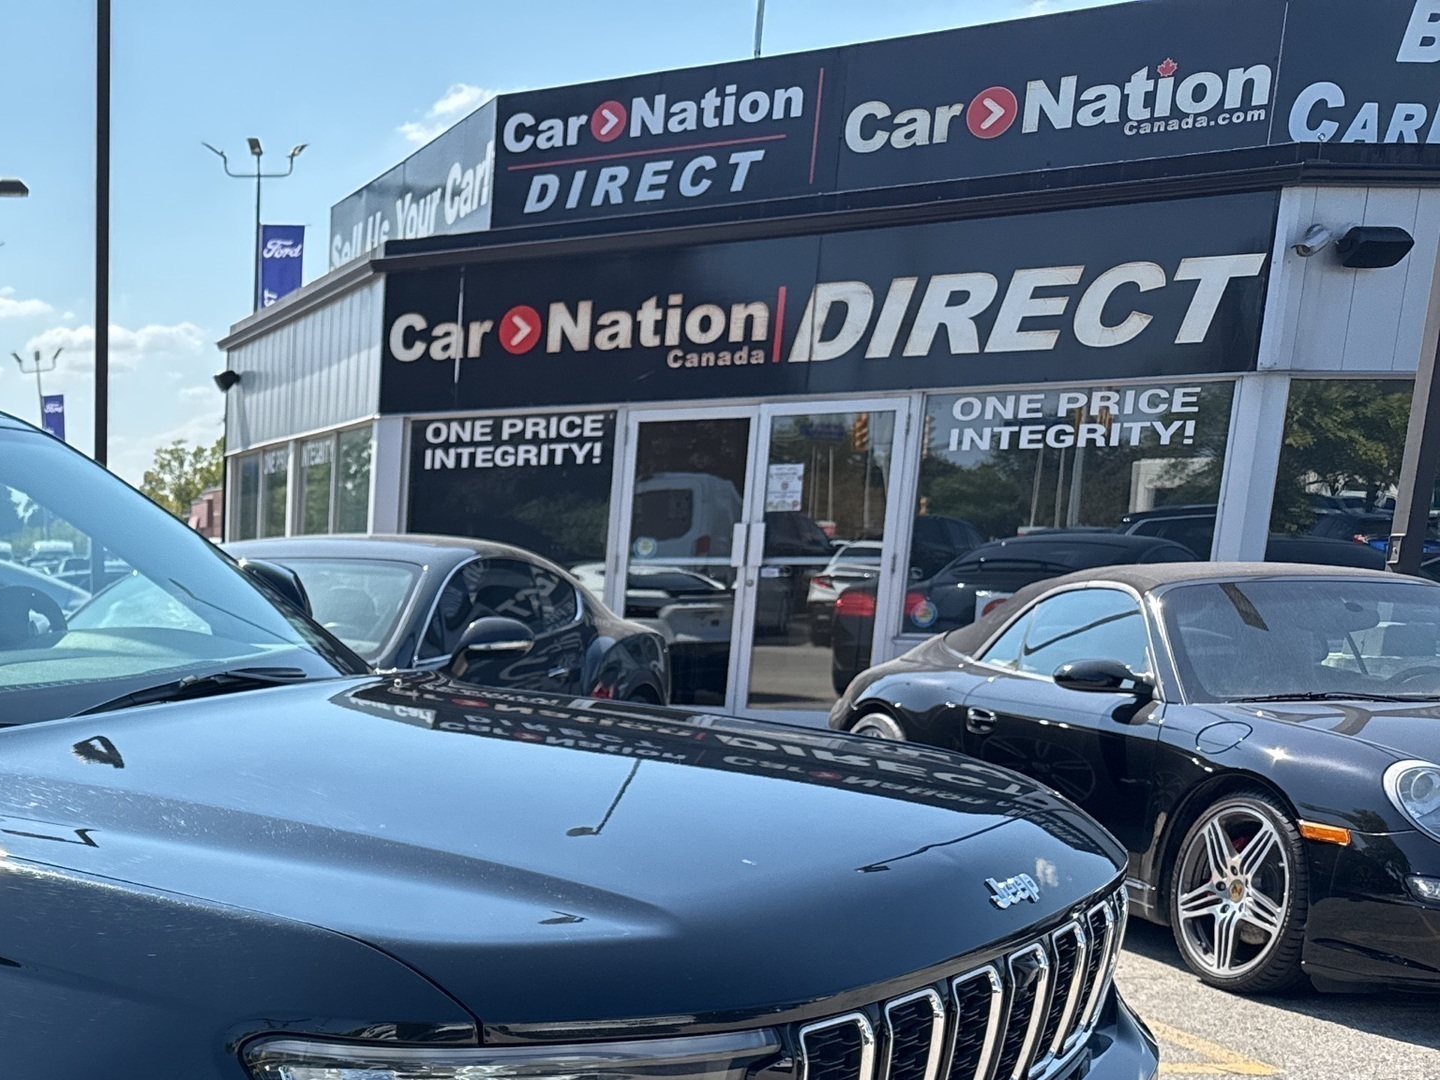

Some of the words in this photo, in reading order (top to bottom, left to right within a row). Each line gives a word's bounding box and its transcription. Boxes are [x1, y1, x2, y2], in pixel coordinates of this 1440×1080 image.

[503, 112, 587, 153] Car
[629, 85, 804, 137] Nation
[845, 100, 964, 154] Car
[1022, 64, 1272, 134] Nation
[1123, 108, 1266, 136] Canada.com
[1288, 81, 1440, 143] CAR
[396, 187, 442, 240] Your
[444, 140, 494, 225] Car!
[523, 150, 765, 213] DIRECT
[263, 238, 302, 258] Ford
[788, 253, 1266, 364] DIRECT
[389, 313, 493, 362] Car
[546, 293, 770, 354] Nation
[667, 346, 765, 368] Canada
[951, 395, 1044, 422] ONE
[1057, 387, 1201, 418] PRICE
[425, 419, 492, 444] ONE
[502, 414, 604, 441] PRICE
[948, 420, 1195, 452] INTEGRITY!
[423, 441, 602, 470] INTEGRITY!
[984, 873, 1040, 909] Jeep
